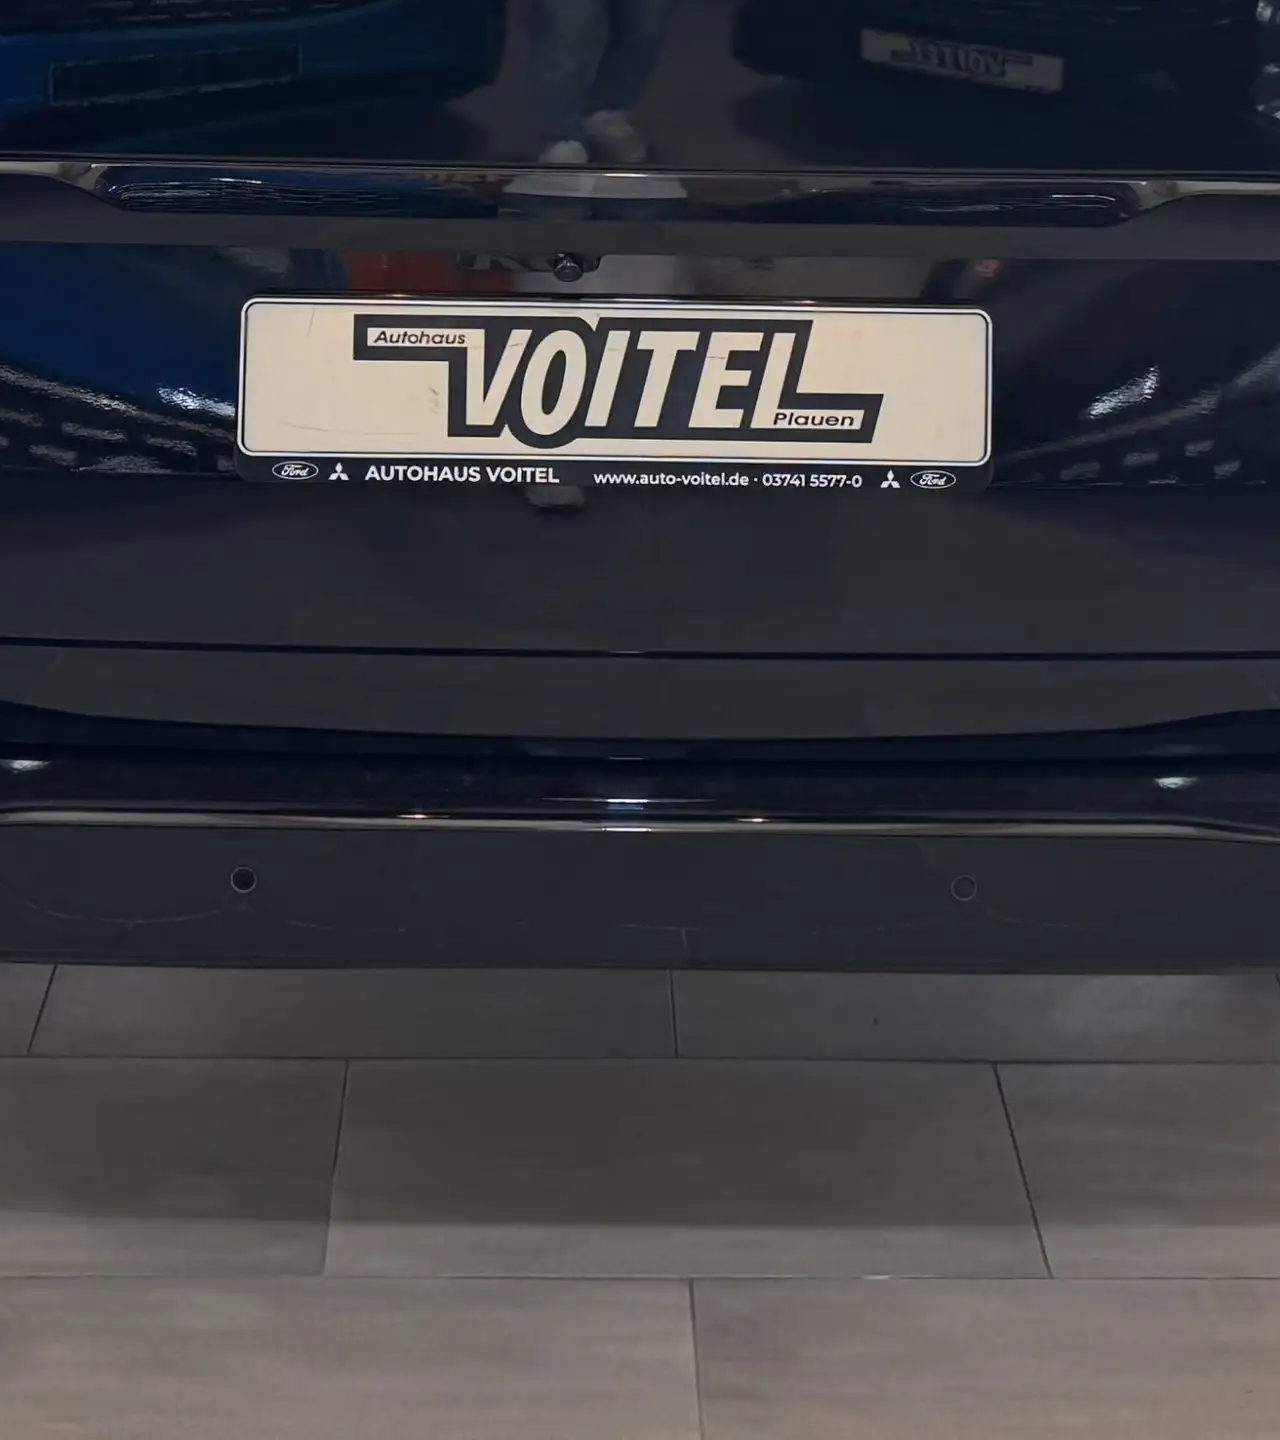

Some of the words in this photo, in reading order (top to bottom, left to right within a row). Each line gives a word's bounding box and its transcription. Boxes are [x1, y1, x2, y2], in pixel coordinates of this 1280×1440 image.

[373, 329, 466, 346] Autohaus
[466, 329, 797, 435] VOITEL
[773, 412, 855, 429] Plauen
[365, 465, 481, 483] AUTOHAUS
[486, 467, 560, 484] VOITEL
[593, 470, 749, 488] www.auto-voitel.de
[762, 474, 806, 489] 03741
[810, 474, 863, 489] 5577-0
